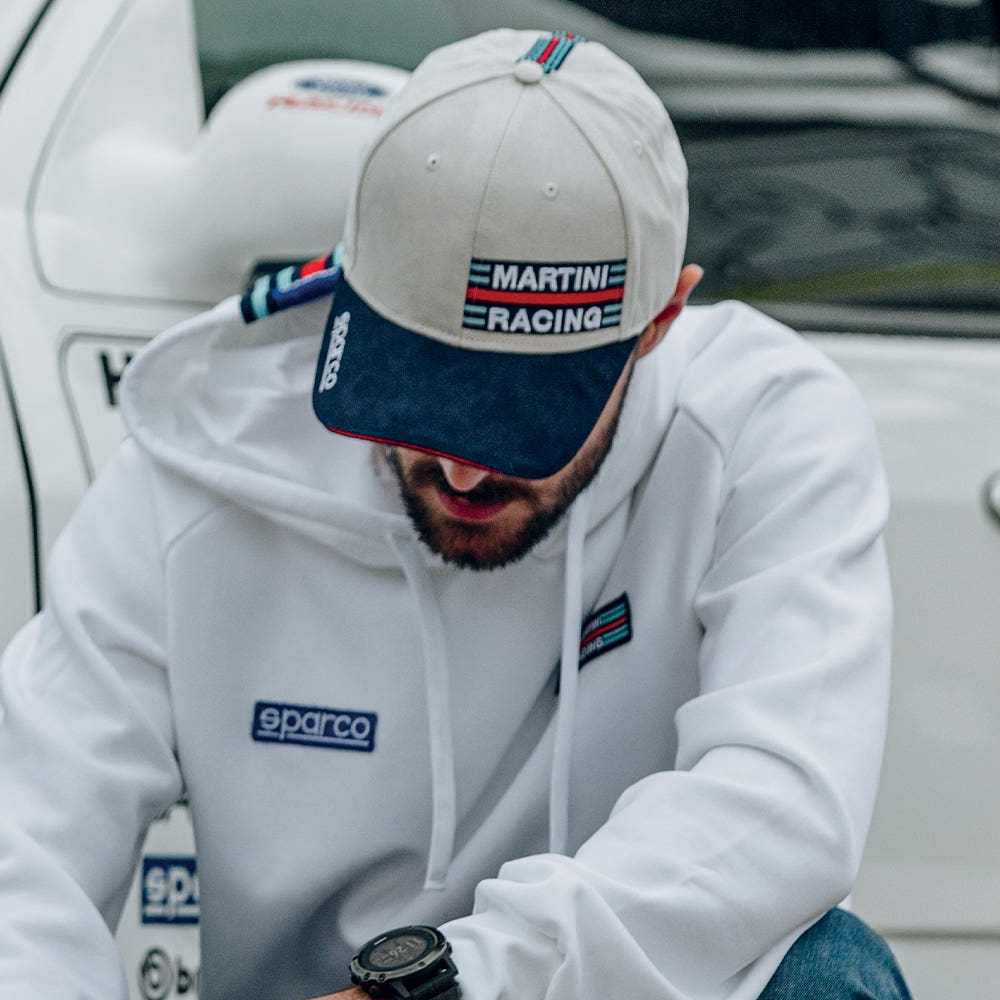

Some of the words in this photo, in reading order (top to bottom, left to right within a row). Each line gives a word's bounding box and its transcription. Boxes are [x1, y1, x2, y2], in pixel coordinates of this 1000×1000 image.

[492, 264, 610, 292] MARTINI
[487, 306, 602, 333] RACING
[319, 311, 351, 393] sparco
[257, 707, 371, 747] sparco
[144, 866, 200, 920] sp
